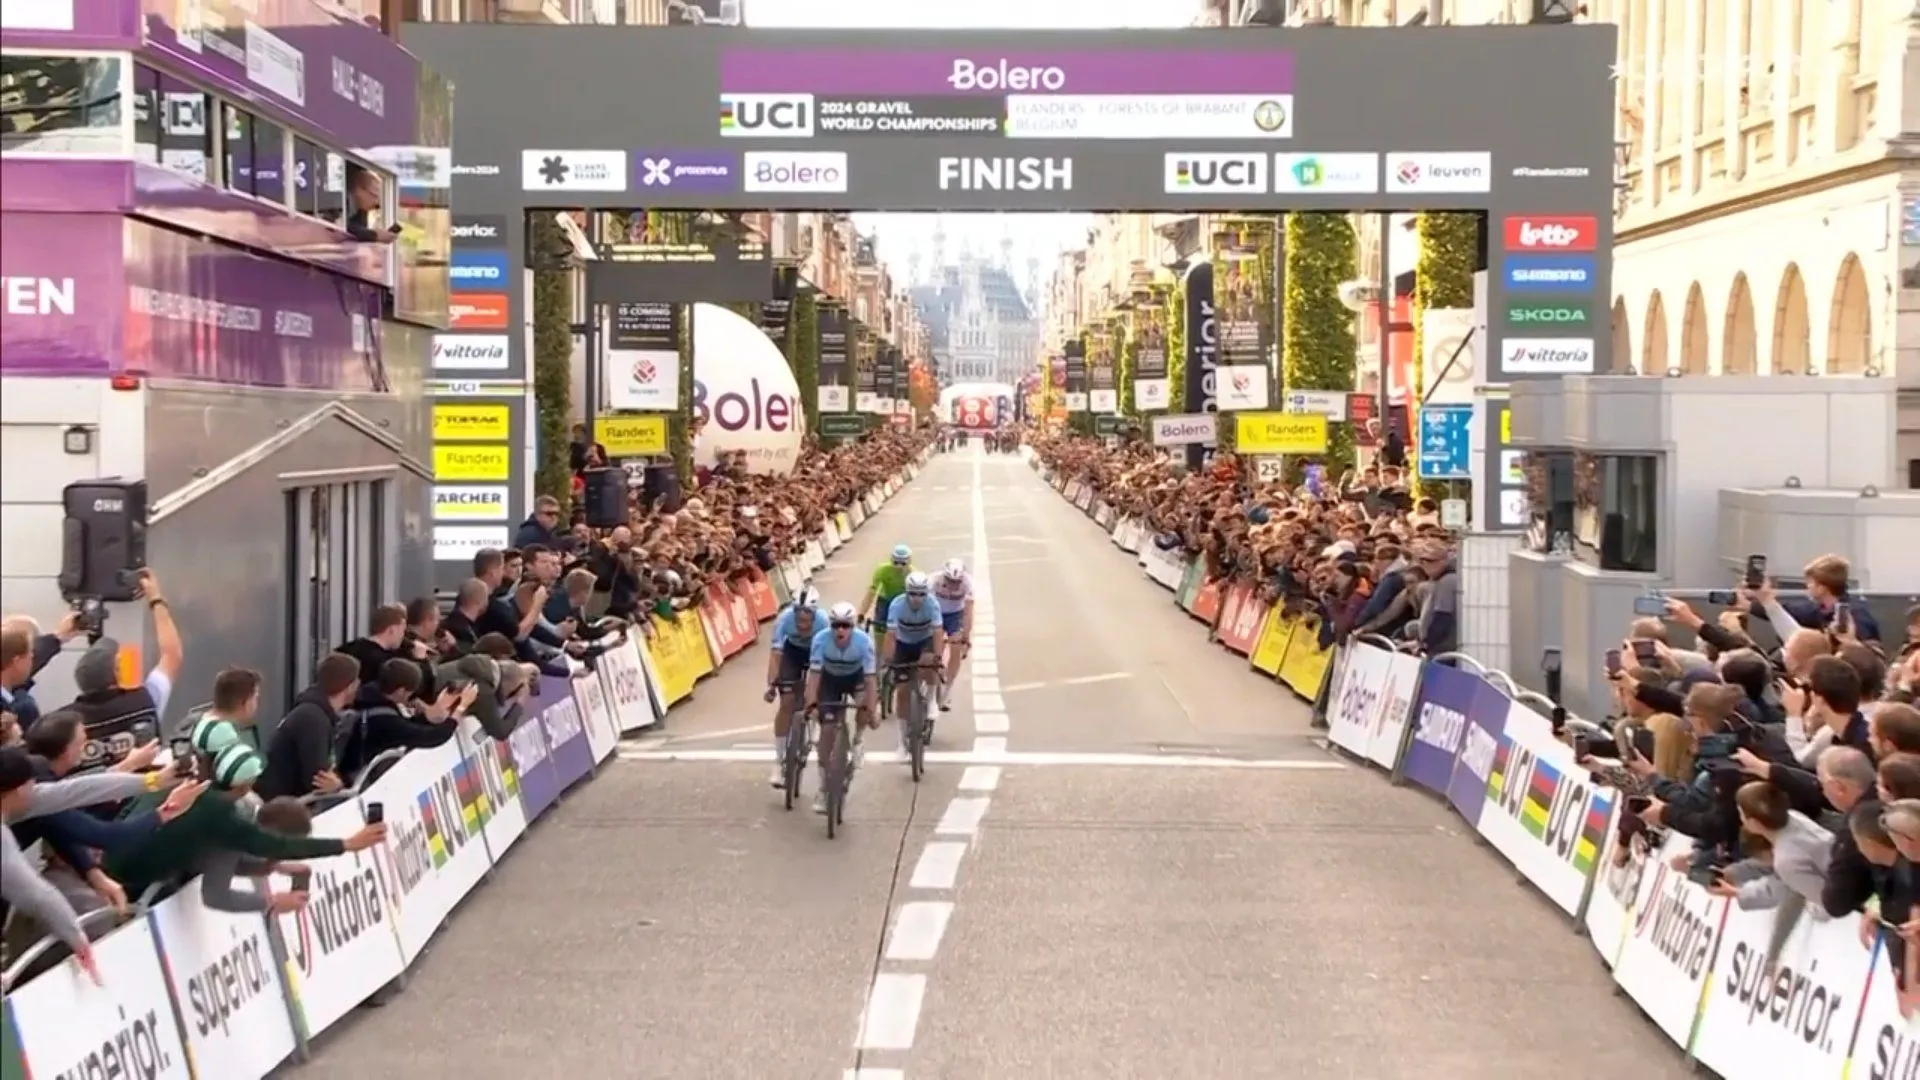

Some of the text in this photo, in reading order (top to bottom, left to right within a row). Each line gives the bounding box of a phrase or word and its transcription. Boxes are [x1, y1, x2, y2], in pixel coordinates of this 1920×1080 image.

[948, 59, 1065, 90] Bolero
[737, 101, 806, 129] UCI
[820, 102, 912, 114] 2024 GRAVEL
[1015, 102, 1246, 114] FLANDERS FORESTS OF BRABANT
[820, 118, 998, 131] WORLD CHAMPIONSHIPS
[1015, 118, 1078, 130] BELGIUM
[674, 165, 728, 177] proximus
[754, 161, 839, 184] Bolero
[939, 156, 1072, 190] FINISH
[1191, 160, 1256, 185] UCI
[1428, 163, 1482, 178] leuven
[450, 224, 498, 237] perior.
[1511, 269, 1587, 282] SHIMANO
[1, 276, 75, 315] EN
[443, 344, 503, 359] vittoria
[1528, 347, 1588, 363] vittoria
[451, 382, 476, 393] UCI
[606, 427, 655, 438] Flanders
[1161, 424, 1210, 437] Bolero
[1266, 424, 1317, 435] Flanders
[446, 452, 502, 465] Flanders
[1260, 463, 1279, 477] 25
[436, 493, 502, 504] ARCHER
[427, 769, 470, 857] UCI
[1544, 774, 1591, 863] UCI
[308, 850, 383, 957] vittoria
[1649, 874, 1713, 981] vittoria
[187, 924, 271, 1037] superior.
[1726, 941, 1843, 1055] superior.
